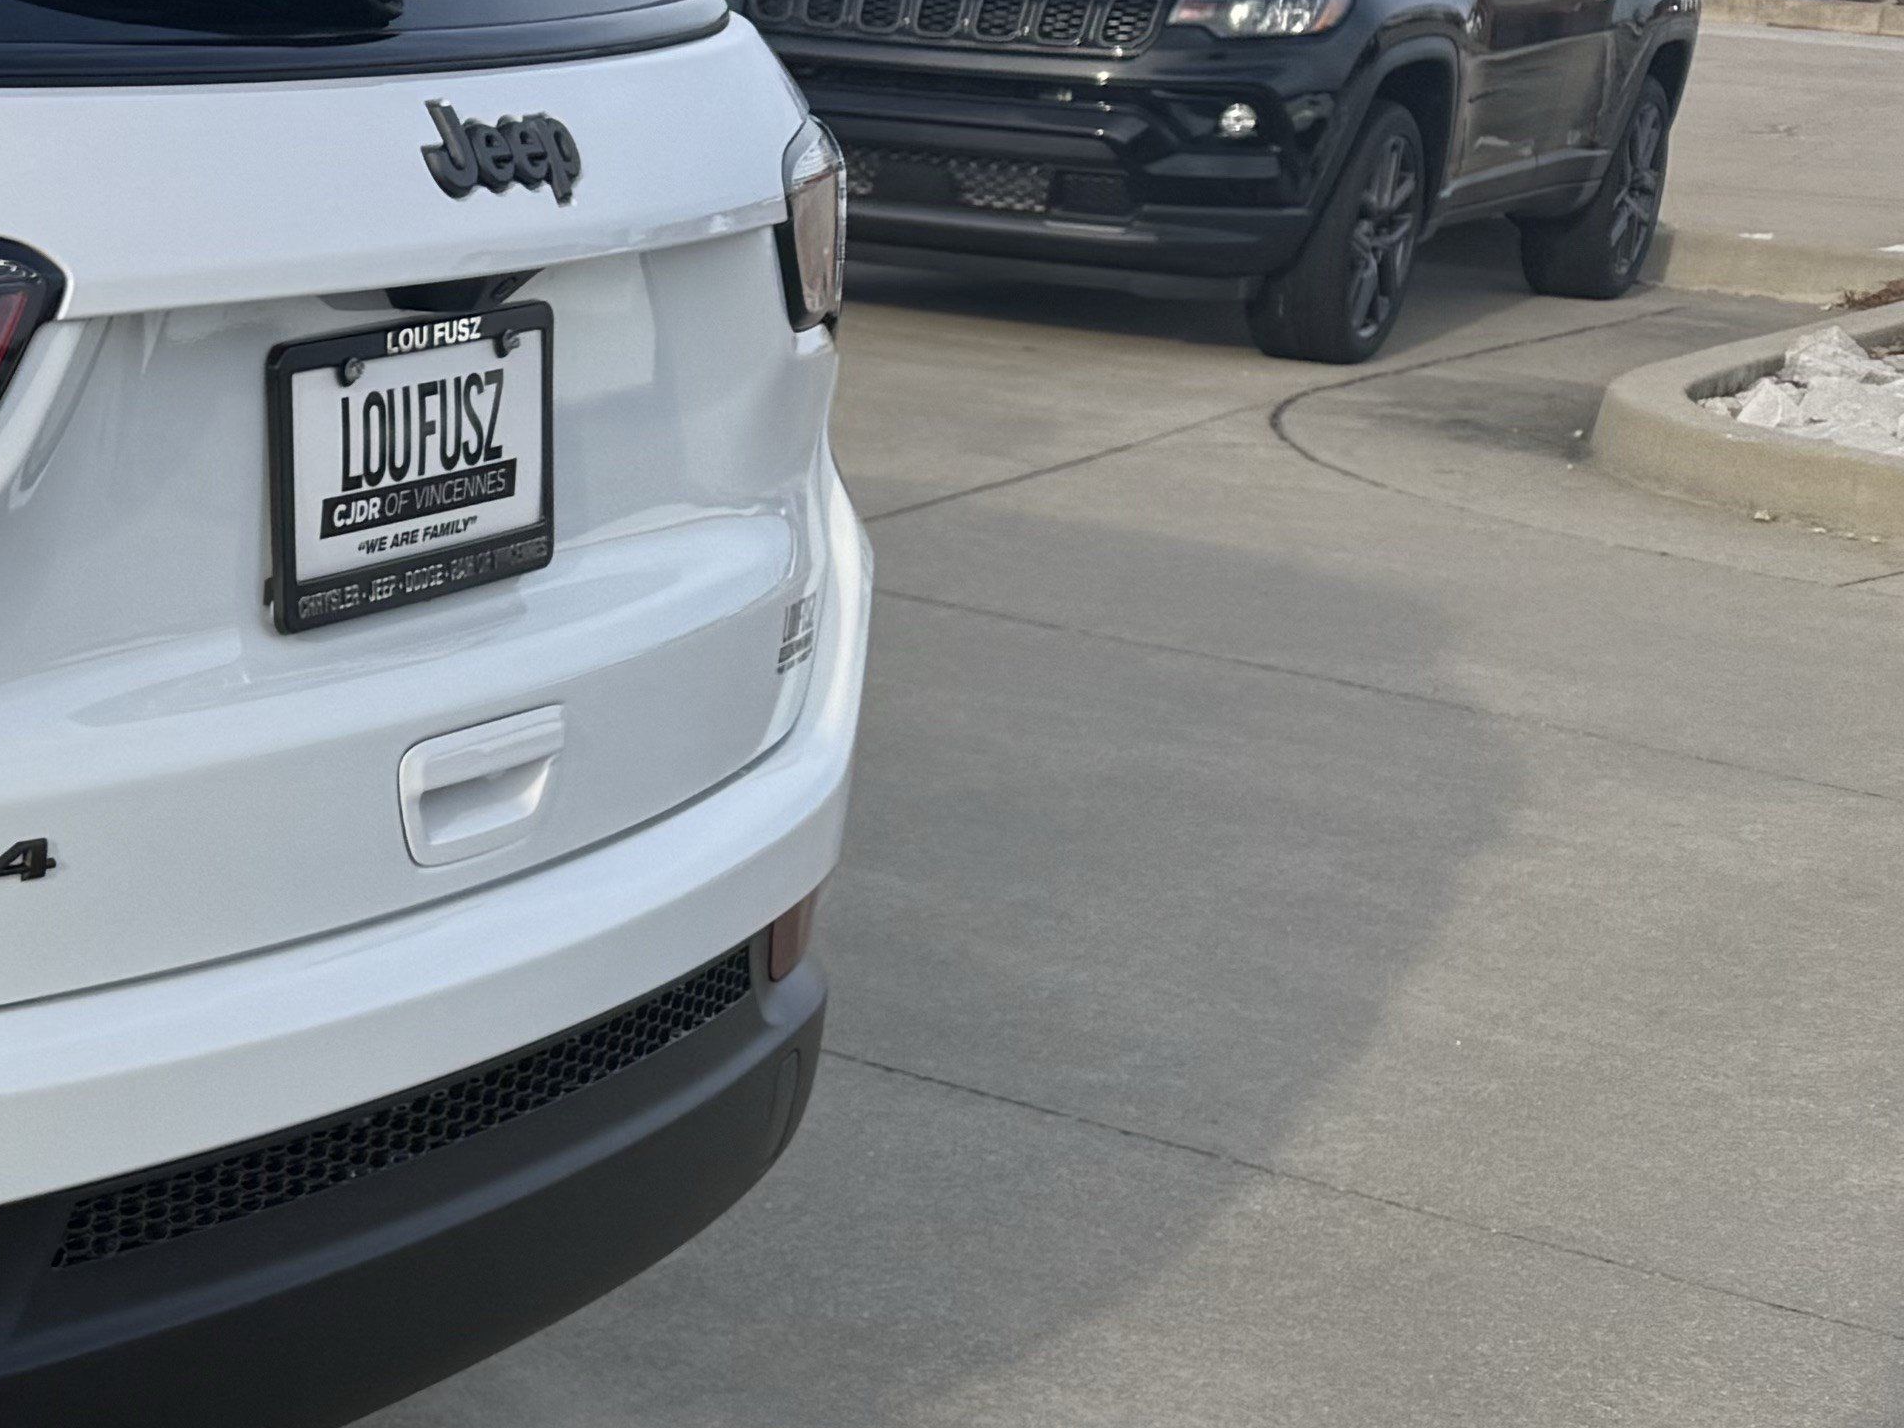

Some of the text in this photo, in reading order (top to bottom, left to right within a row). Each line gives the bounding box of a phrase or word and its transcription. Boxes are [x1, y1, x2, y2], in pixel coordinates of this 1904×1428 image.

[420, 98, 582, 208] Jeep
[386, 316, 482, 355] LOU FUSZ
[341, 368, 504, 492] LOU FUSZ
[332, 468, 507, 528] CJDR OF VINCENNES
[389, 528, 419, 549] ARE
[297, 583, 361, 619] CHRYSLER
[368, 574, 398, 603] JEEP
[404, 563, 444, 594] DODGE
